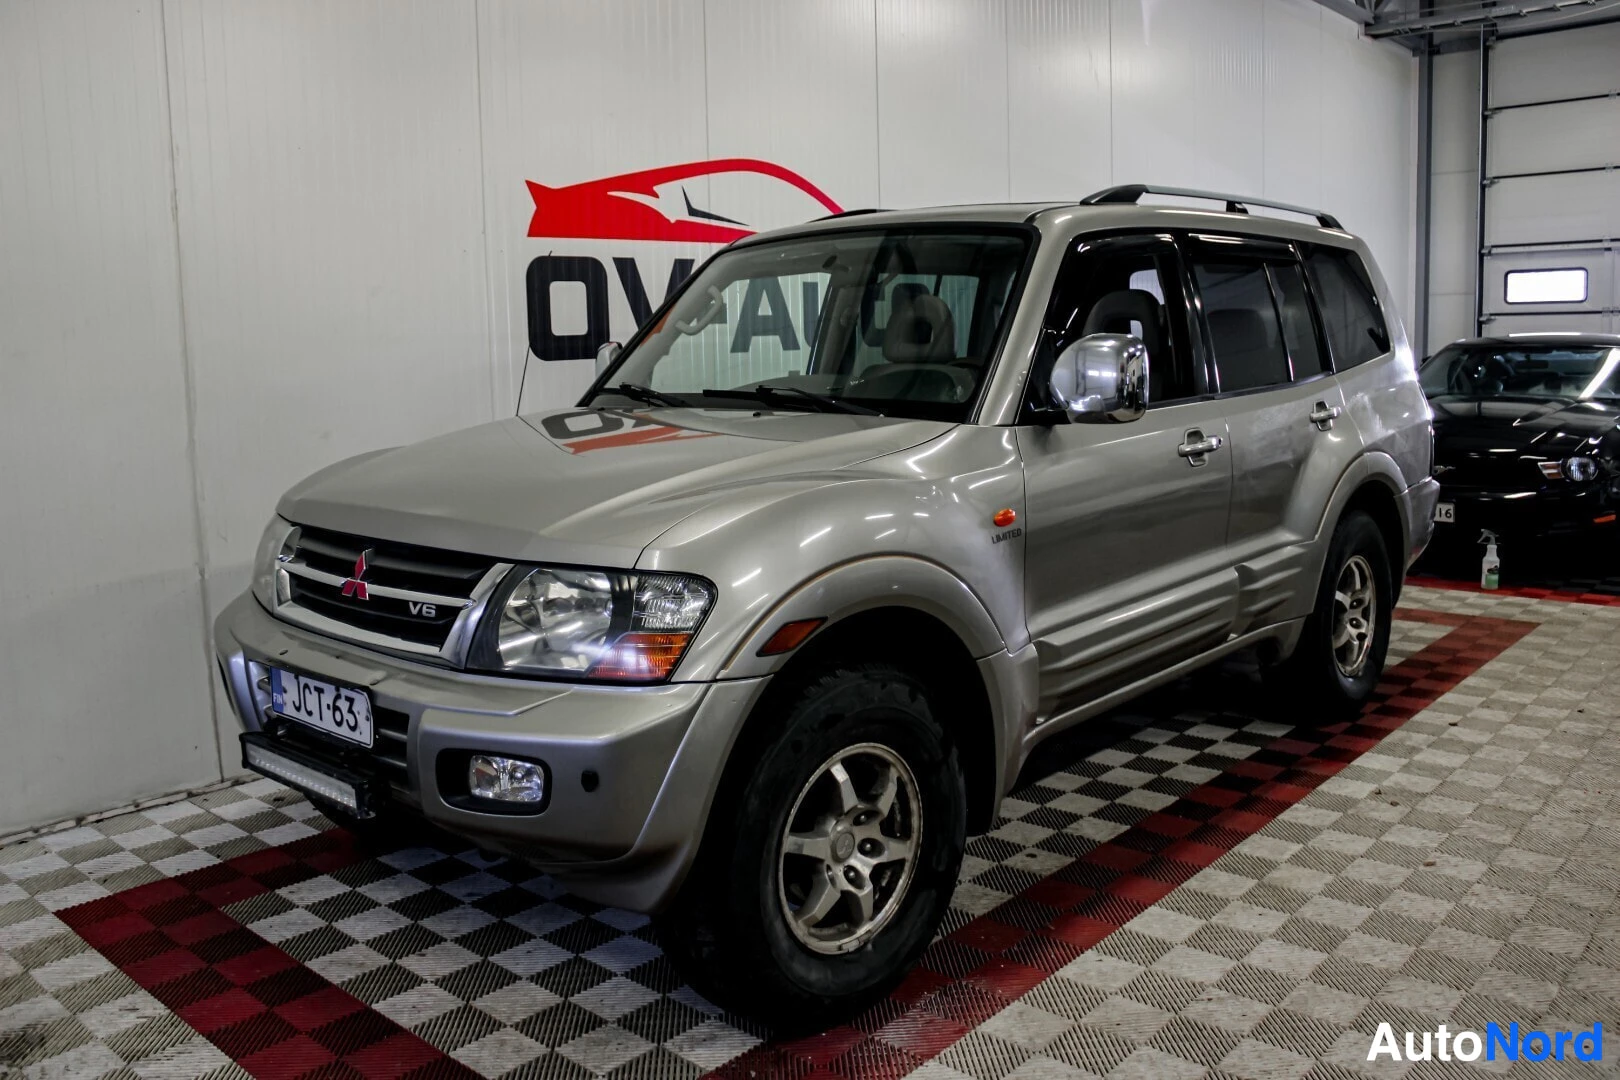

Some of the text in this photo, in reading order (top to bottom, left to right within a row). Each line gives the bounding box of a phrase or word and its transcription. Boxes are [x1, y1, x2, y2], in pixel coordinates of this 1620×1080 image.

[991, 528, 1022, 544] LIMITED
[408, 601, 437, 618] V6
[273, 692, 283, 705] FIN
[292, 676, 358, 733] JCT-63
